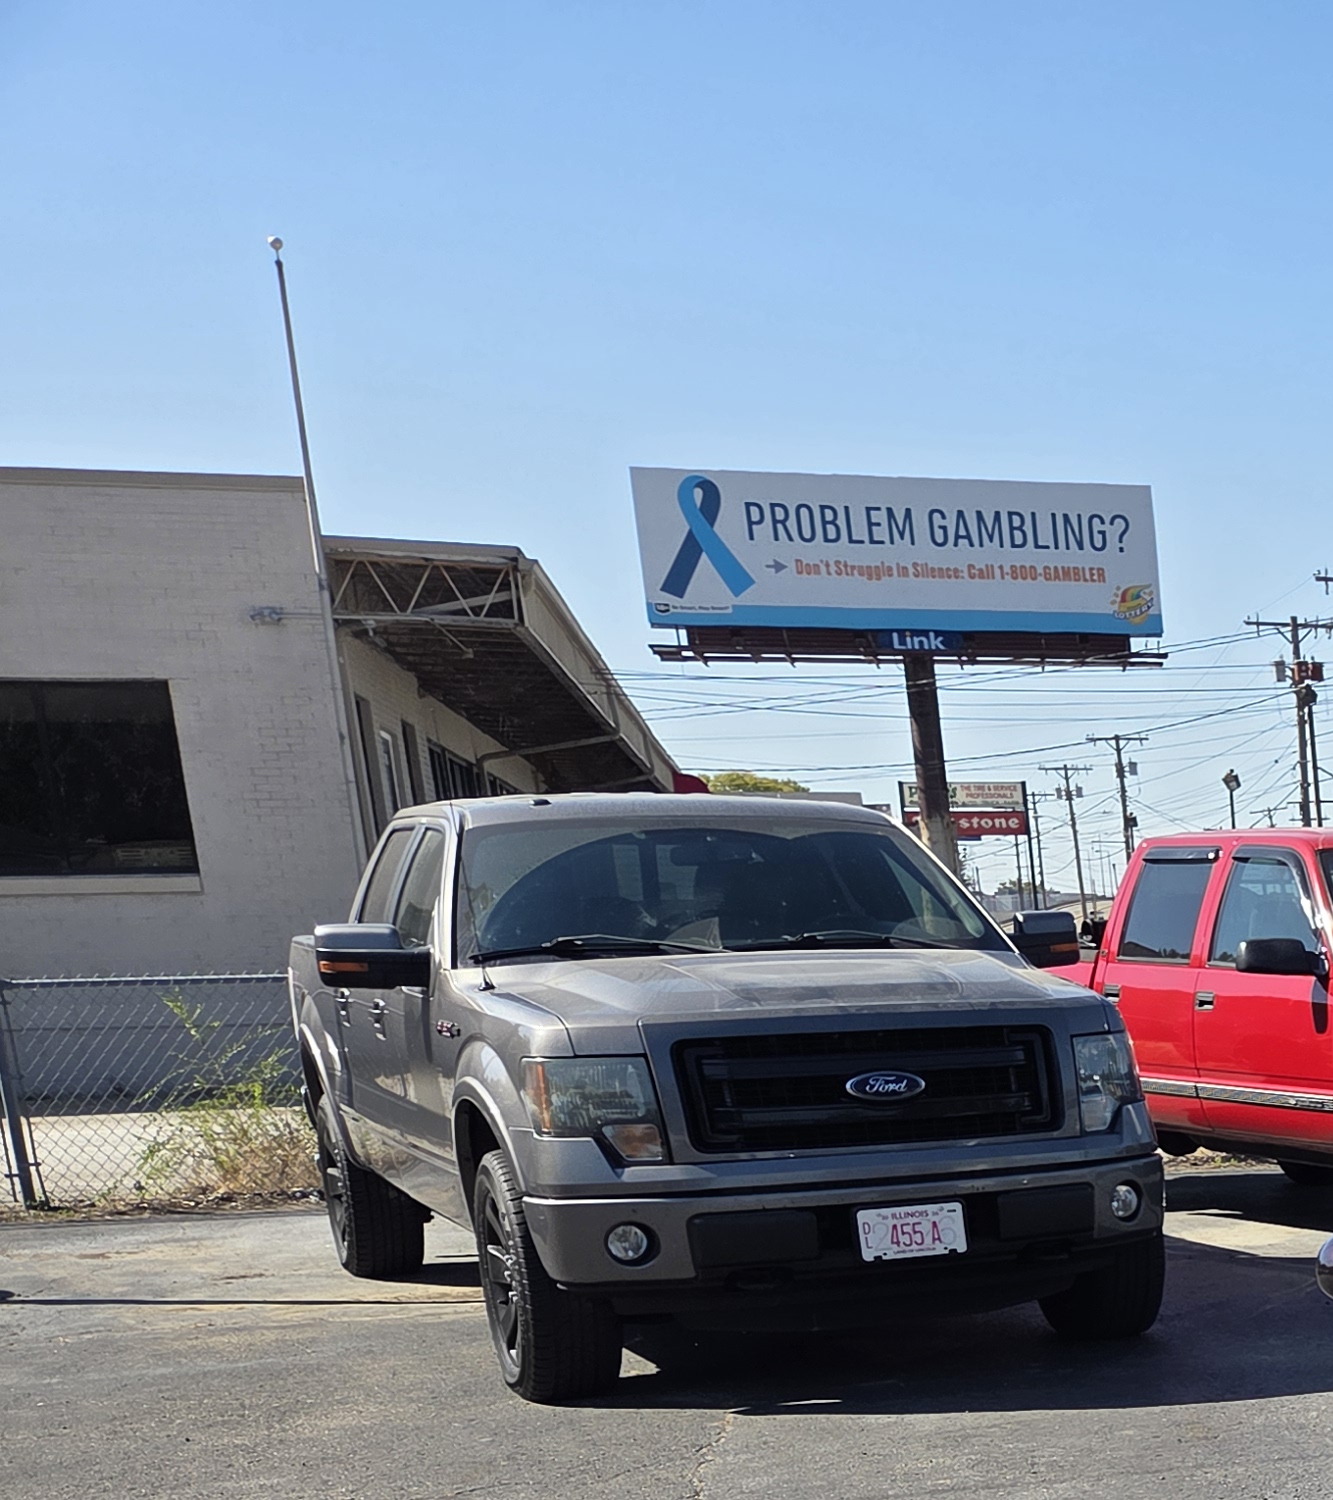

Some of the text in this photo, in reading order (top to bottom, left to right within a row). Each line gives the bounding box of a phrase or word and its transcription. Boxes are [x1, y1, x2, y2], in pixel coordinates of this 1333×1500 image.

[744, 501, 1131, 553] PROBLEM GAMBLING?
[794, 558, 1107, 584] Don't Struggle In Silence: Call 1-800-GAMBLER
[1114, 601, 1154, 619] LOTTERY
[892, 631, 948, 650] Link
[865, 1076, 907, 1093] Ford
[891, 1210, 929, 1220] ILLINOIS
[890, 1222, 925, 1247] 455
[931, 1220, 943, 1245] A
